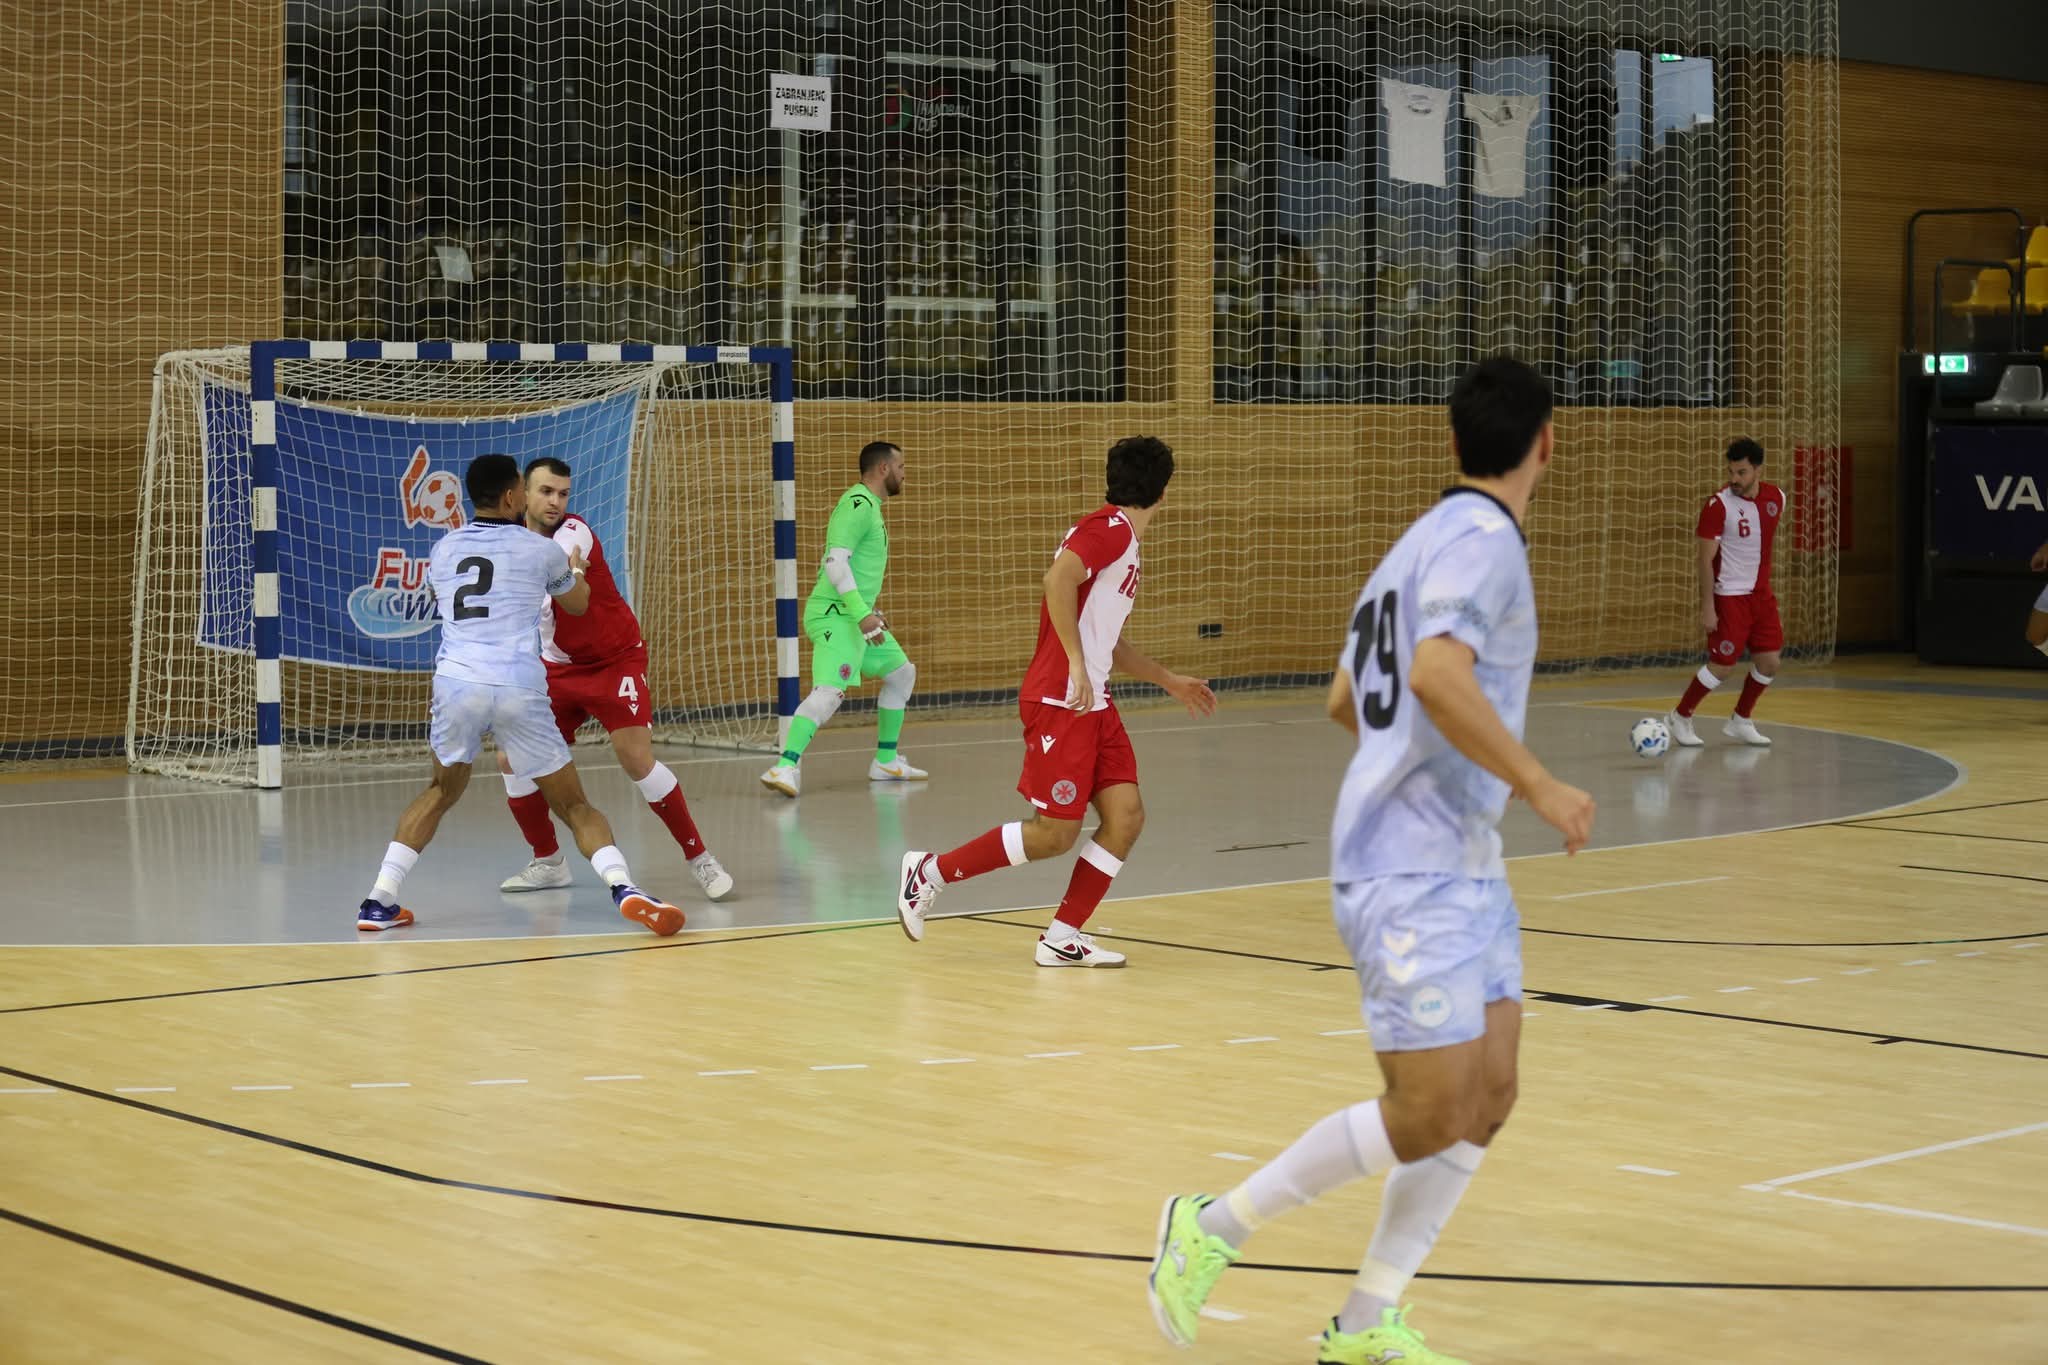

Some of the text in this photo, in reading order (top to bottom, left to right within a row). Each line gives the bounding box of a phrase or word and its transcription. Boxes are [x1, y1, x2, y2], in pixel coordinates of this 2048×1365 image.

[1975, 474, 2048, 512] VA
[1738, 518, 1751, 538] 6
[453, 556, 495, 621] 2
[1352, 589, 1400, 730] 19
[617, 676, 639, 701] 4
